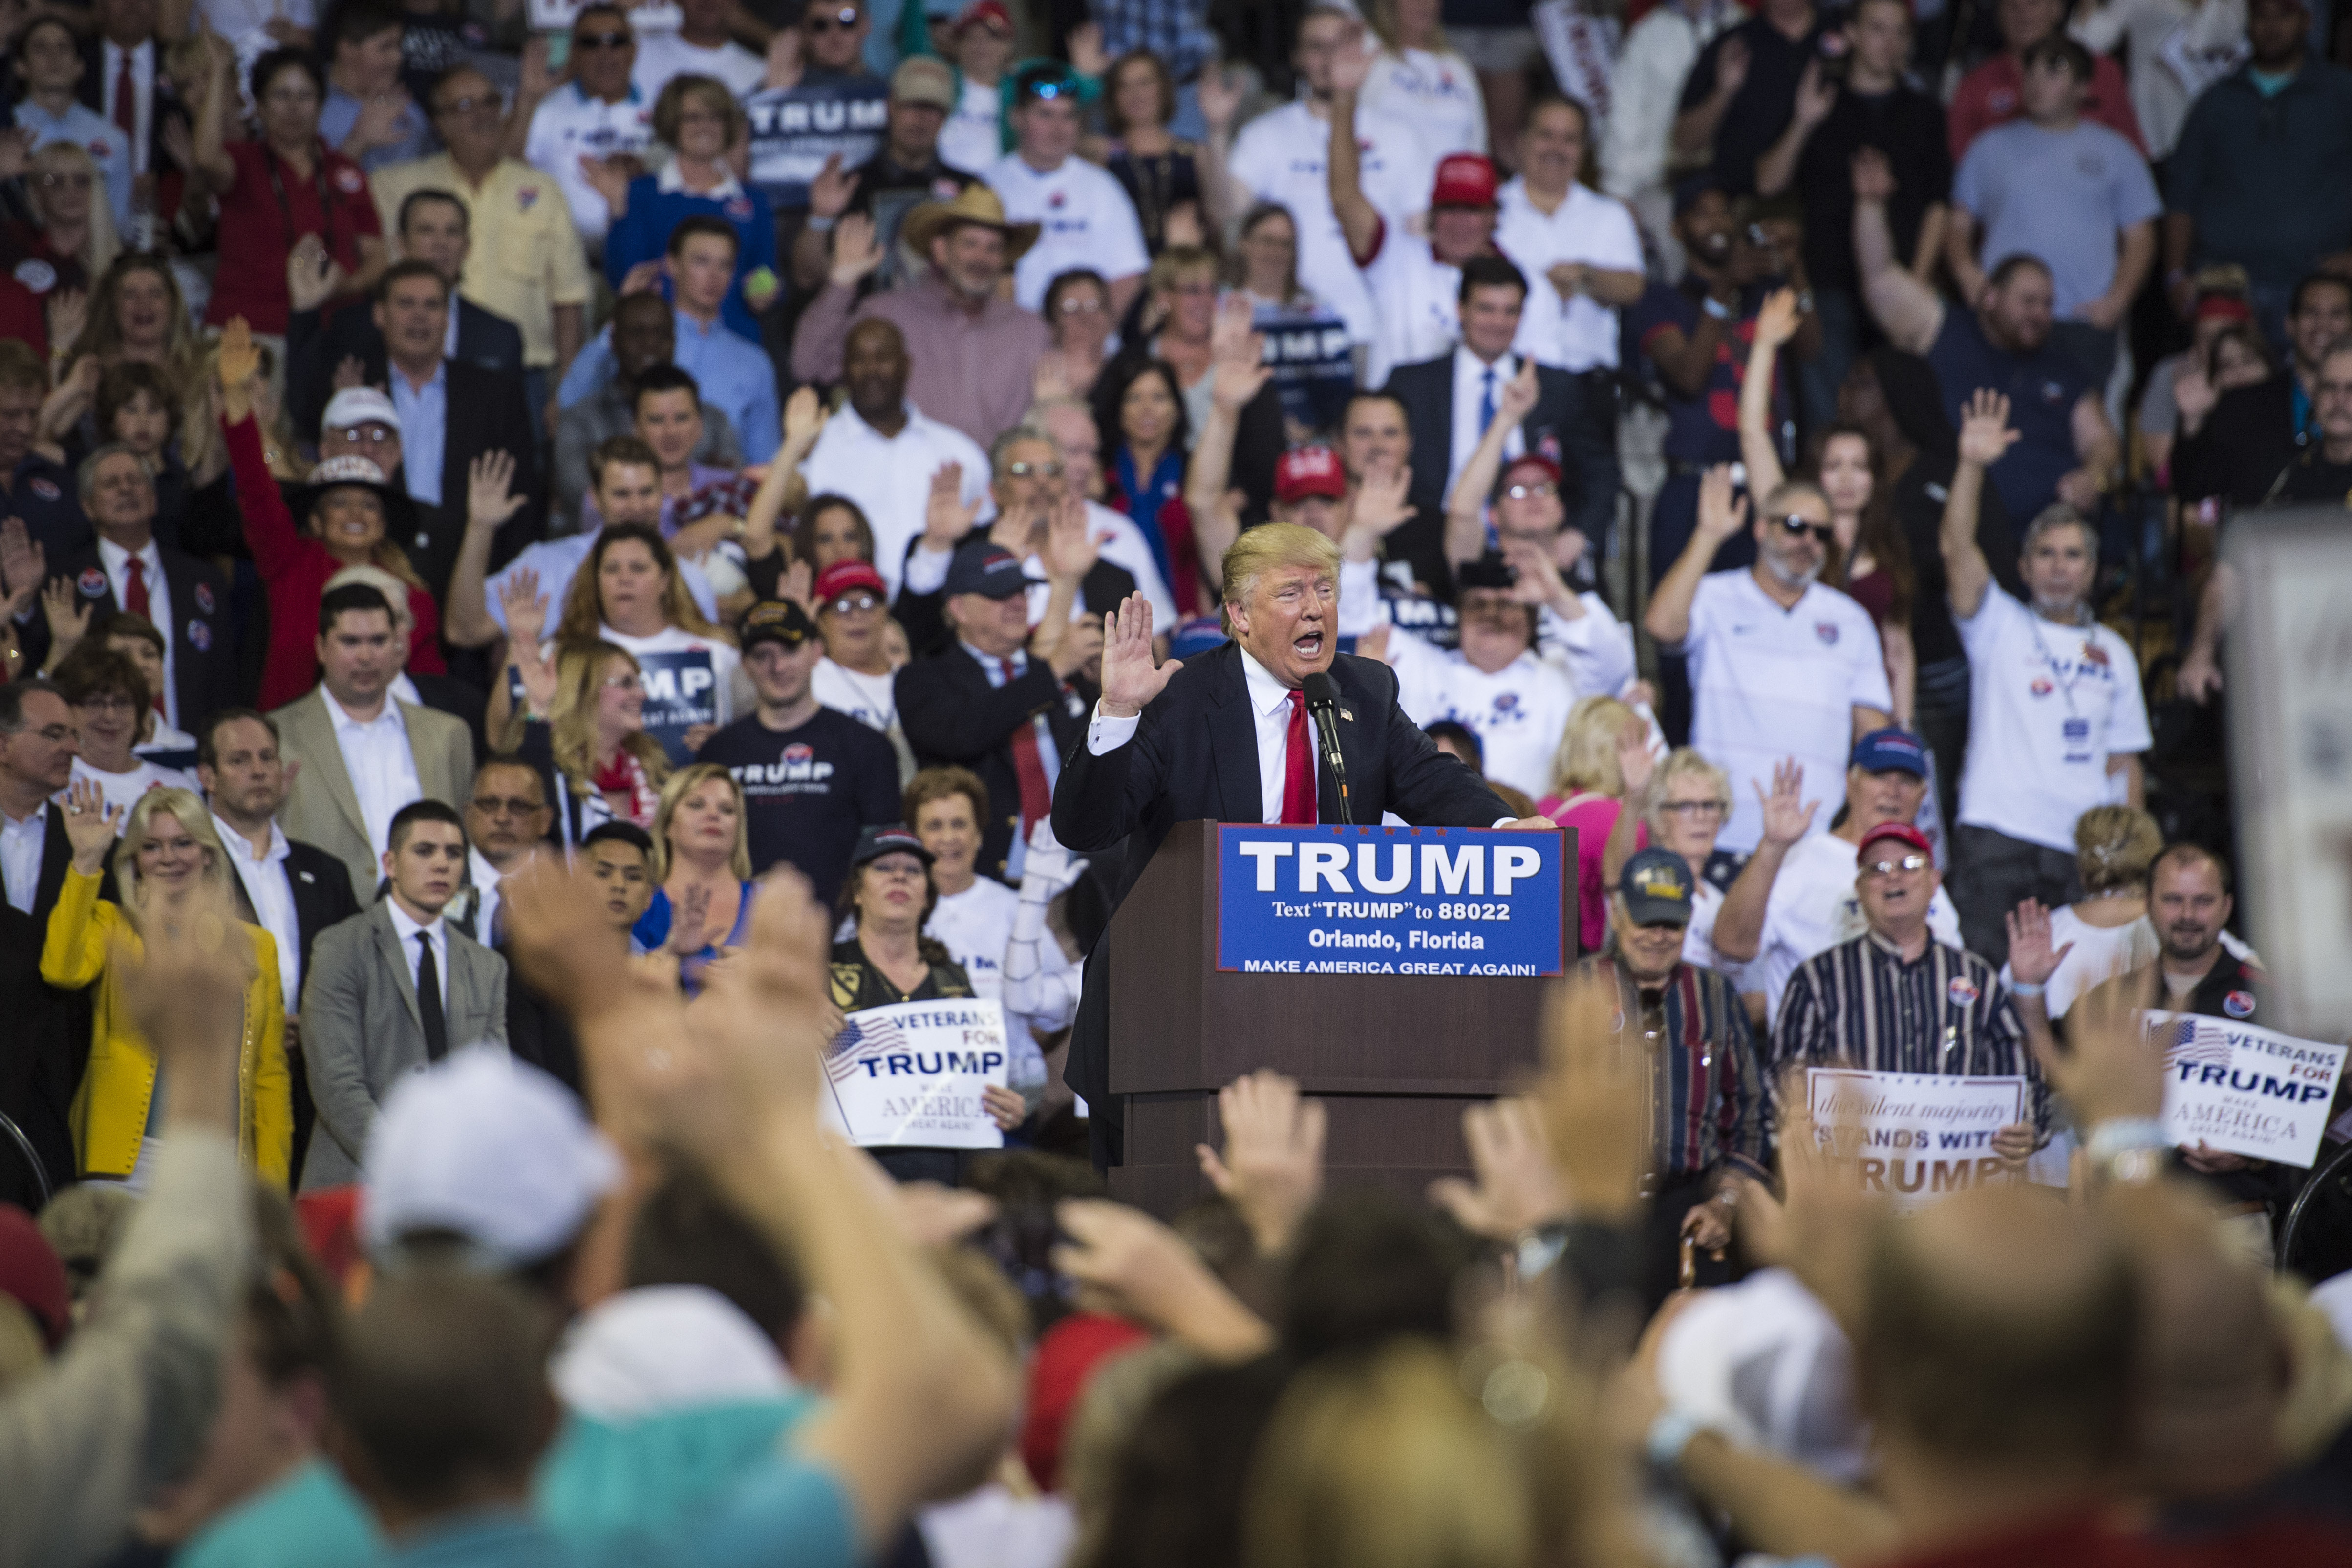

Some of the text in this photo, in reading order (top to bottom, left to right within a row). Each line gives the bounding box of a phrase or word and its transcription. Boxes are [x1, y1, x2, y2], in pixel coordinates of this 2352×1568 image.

[1239, 841, 1541, 895] TRUMP
[1272, 902, 1311, 917] Text
[1415, 905, 1433, 920] to
[1438, 902, 1510, 920] 88022
[1308, 928, 1484, 952] Orlando, Florida
[1244, 960, 1536, 976] MAKE AMERICA GREAT AGAIN!
[892, 1010, 997, 1029] VETERANS
[963, 1030, 1000, 1045] FOR
[2226, 1031, 2338, 1066] VETERANS
[858, 1051, 1003, 1077] TRUMP
[2289, 1063, 2332, 1082] FOR
[2176, 1059, 2328, 1103] TRUMP
[1919, 1099, 2012, 1124] majority
[2174, 1102, 2298, 1140] AMERICA
[1938, 1130, 1997, 1150] WIT
